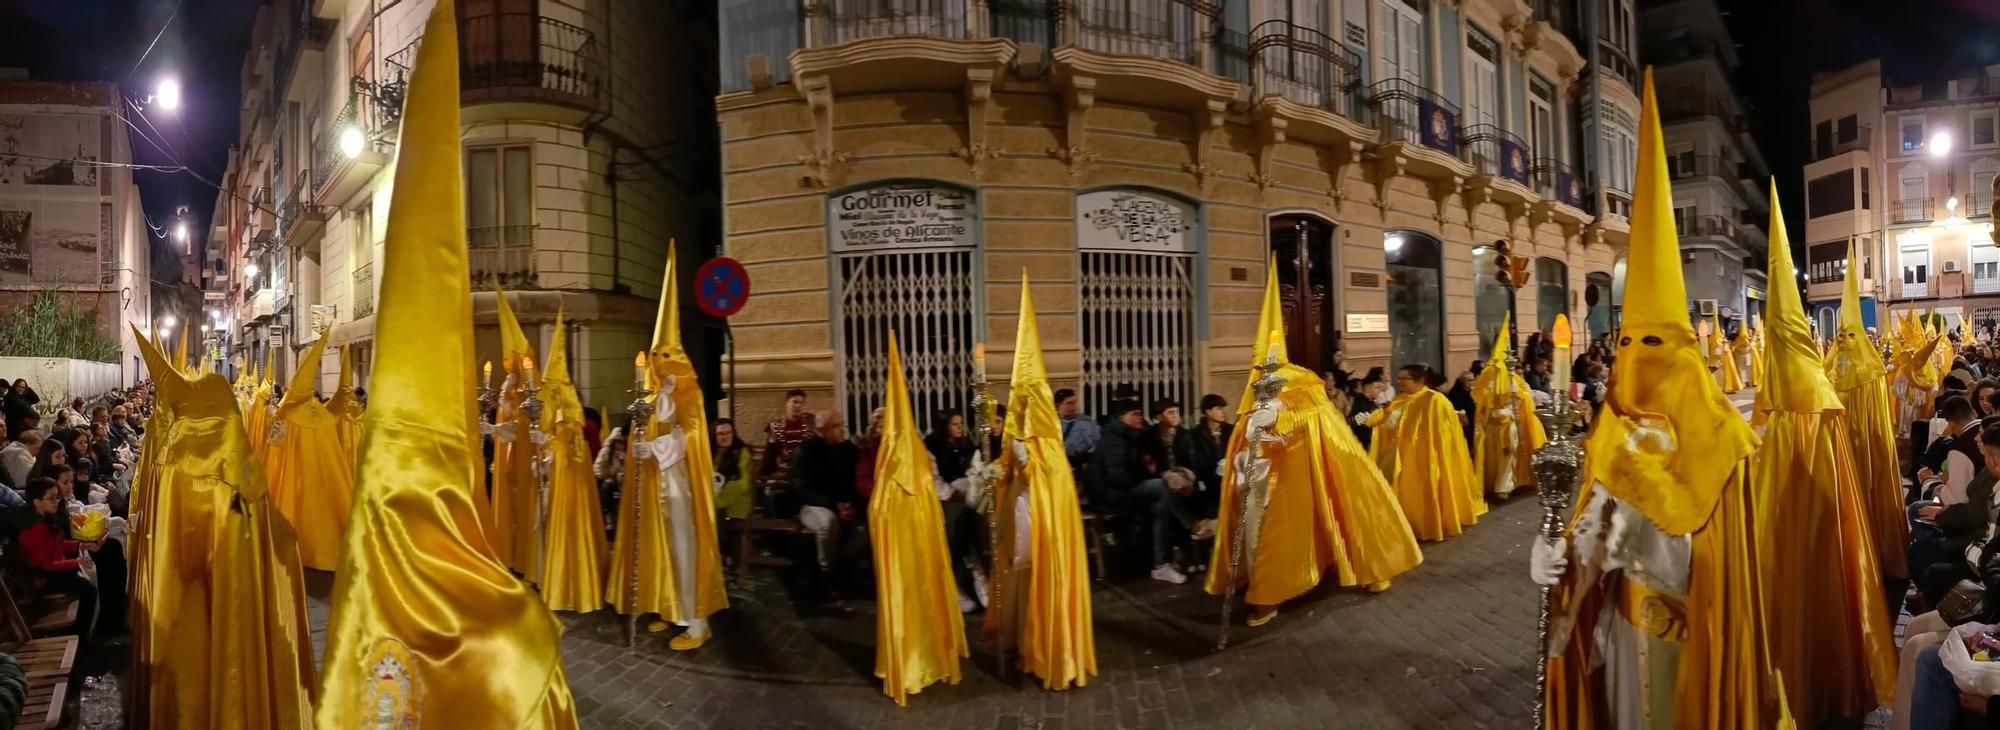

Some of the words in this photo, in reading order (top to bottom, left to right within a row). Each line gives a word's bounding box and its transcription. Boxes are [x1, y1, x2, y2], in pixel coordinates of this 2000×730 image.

[841, 190, 933, 211] Gourmet
[1122, 213, 1139, 225] DE
[840, 229, 879, 240] Vinos
[883, 226, 901, 238] de
[905, 225, 965, 238] Alicante
[1112, 225, 1170, 243] VEGA
